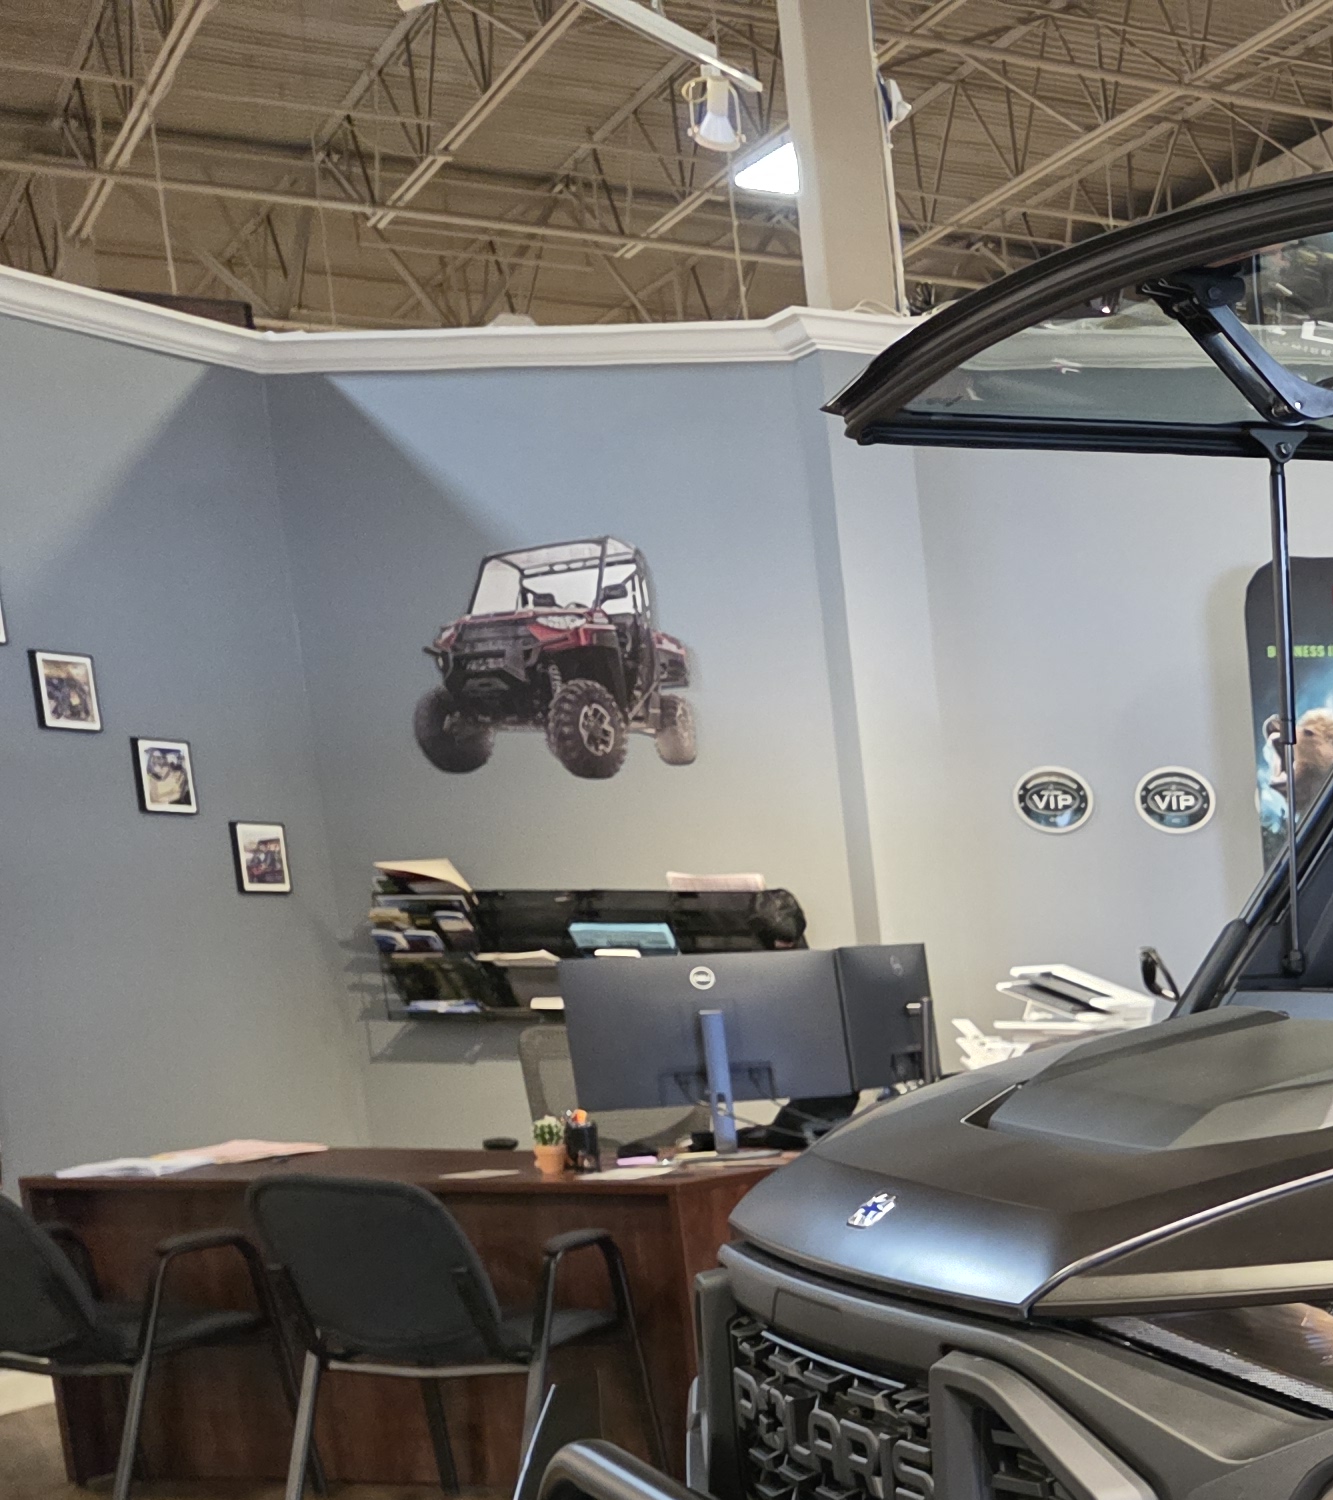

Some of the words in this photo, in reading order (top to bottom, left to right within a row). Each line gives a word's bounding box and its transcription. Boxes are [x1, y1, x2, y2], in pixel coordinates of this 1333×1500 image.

[1266, 644, 1325, 658] BNESS
[1031, 794, 1074, 810] VIP
[1154, 794, 1196, 811] VIP
